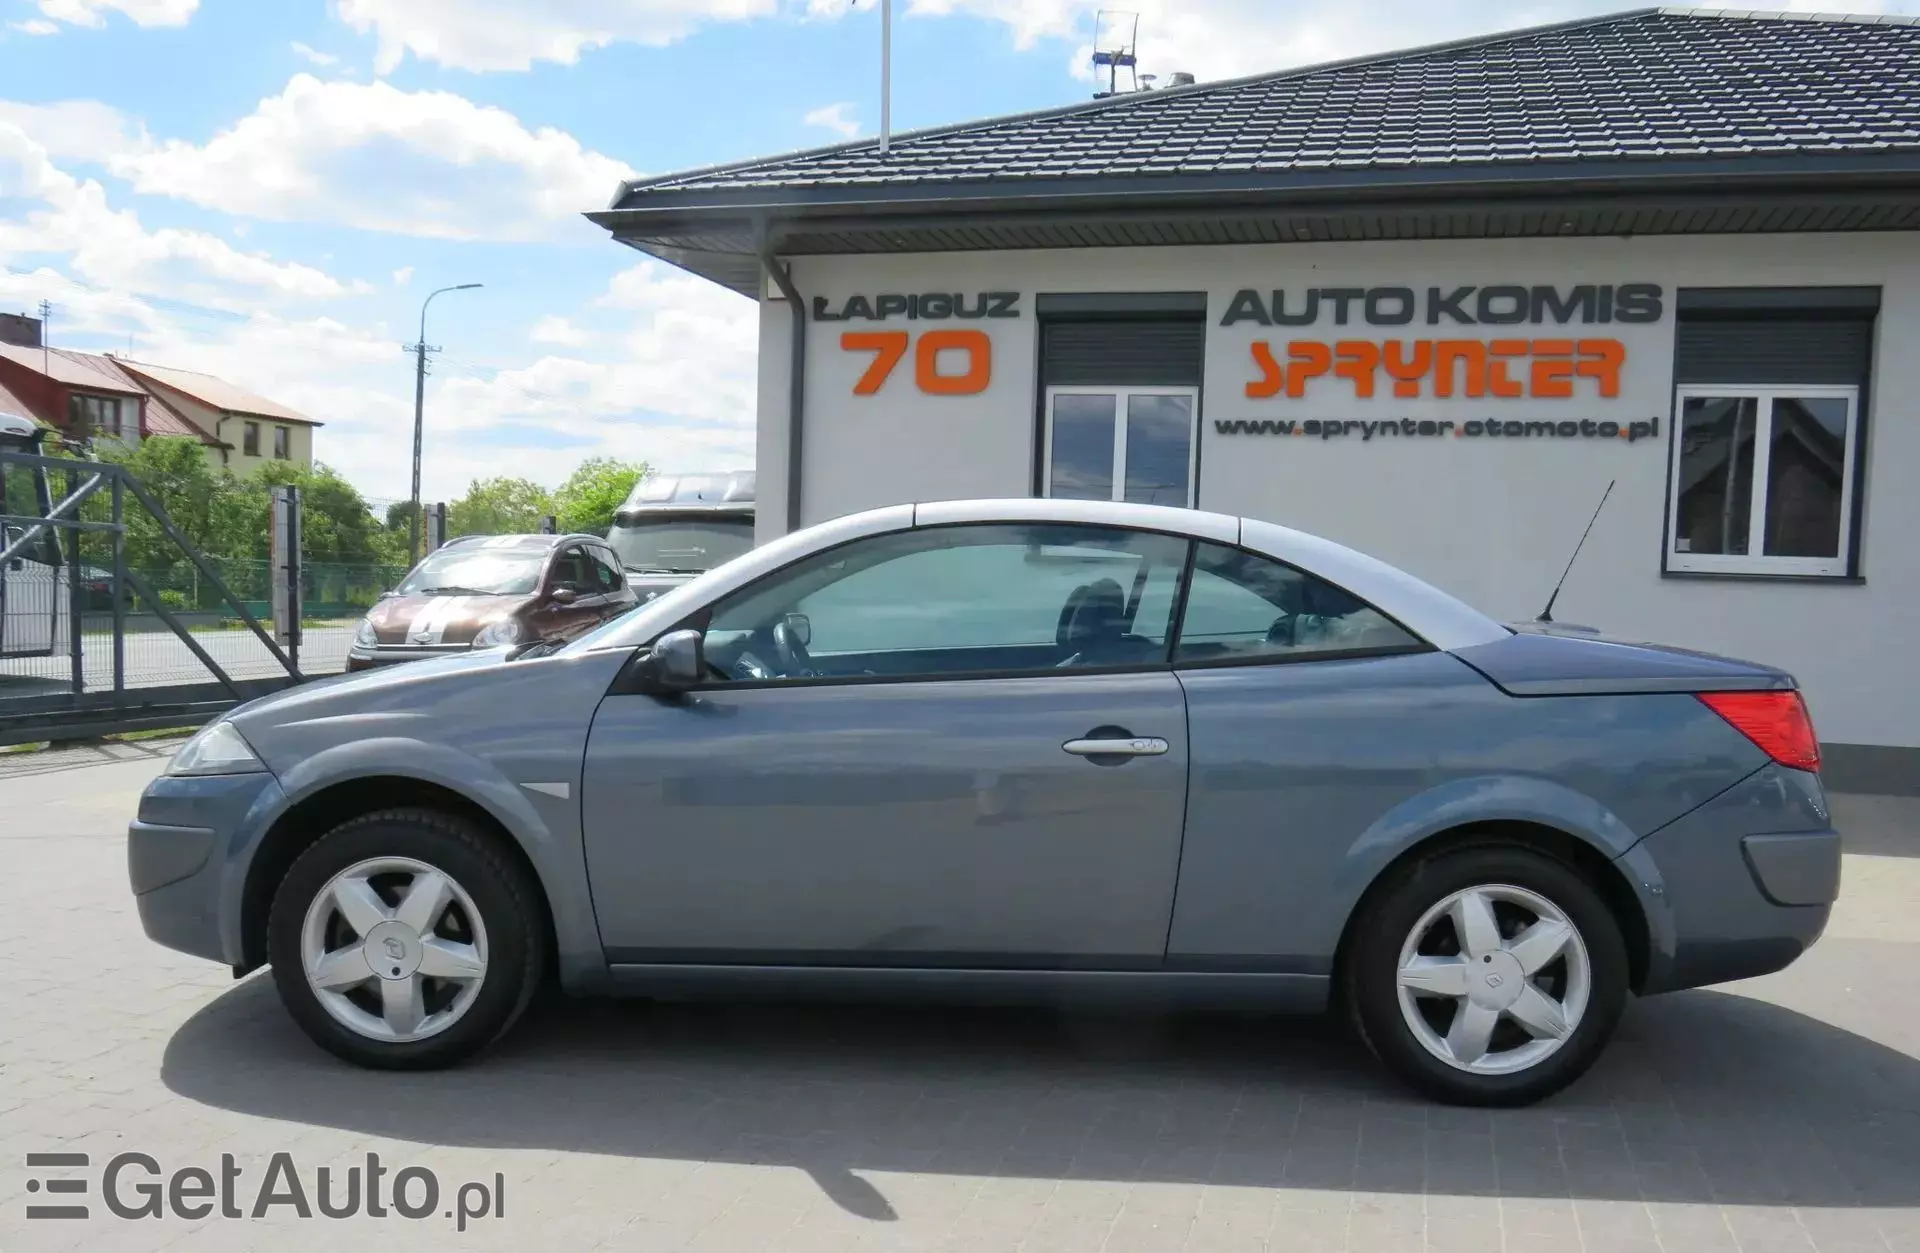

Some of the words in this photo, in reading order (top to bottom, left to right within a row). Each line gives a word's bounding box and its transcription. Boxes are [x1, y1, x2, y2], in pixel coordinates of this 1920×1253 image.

[1219, 287, 1416, 326] AUTO
[1426, 283, 1663, 325] KOMIS
[840, 329, 992, 396] 70
[1245, 338, 1626, 398] SPRYNTER
[1214, 416, 1659, 442] www.sprynter.otomoto.pl
